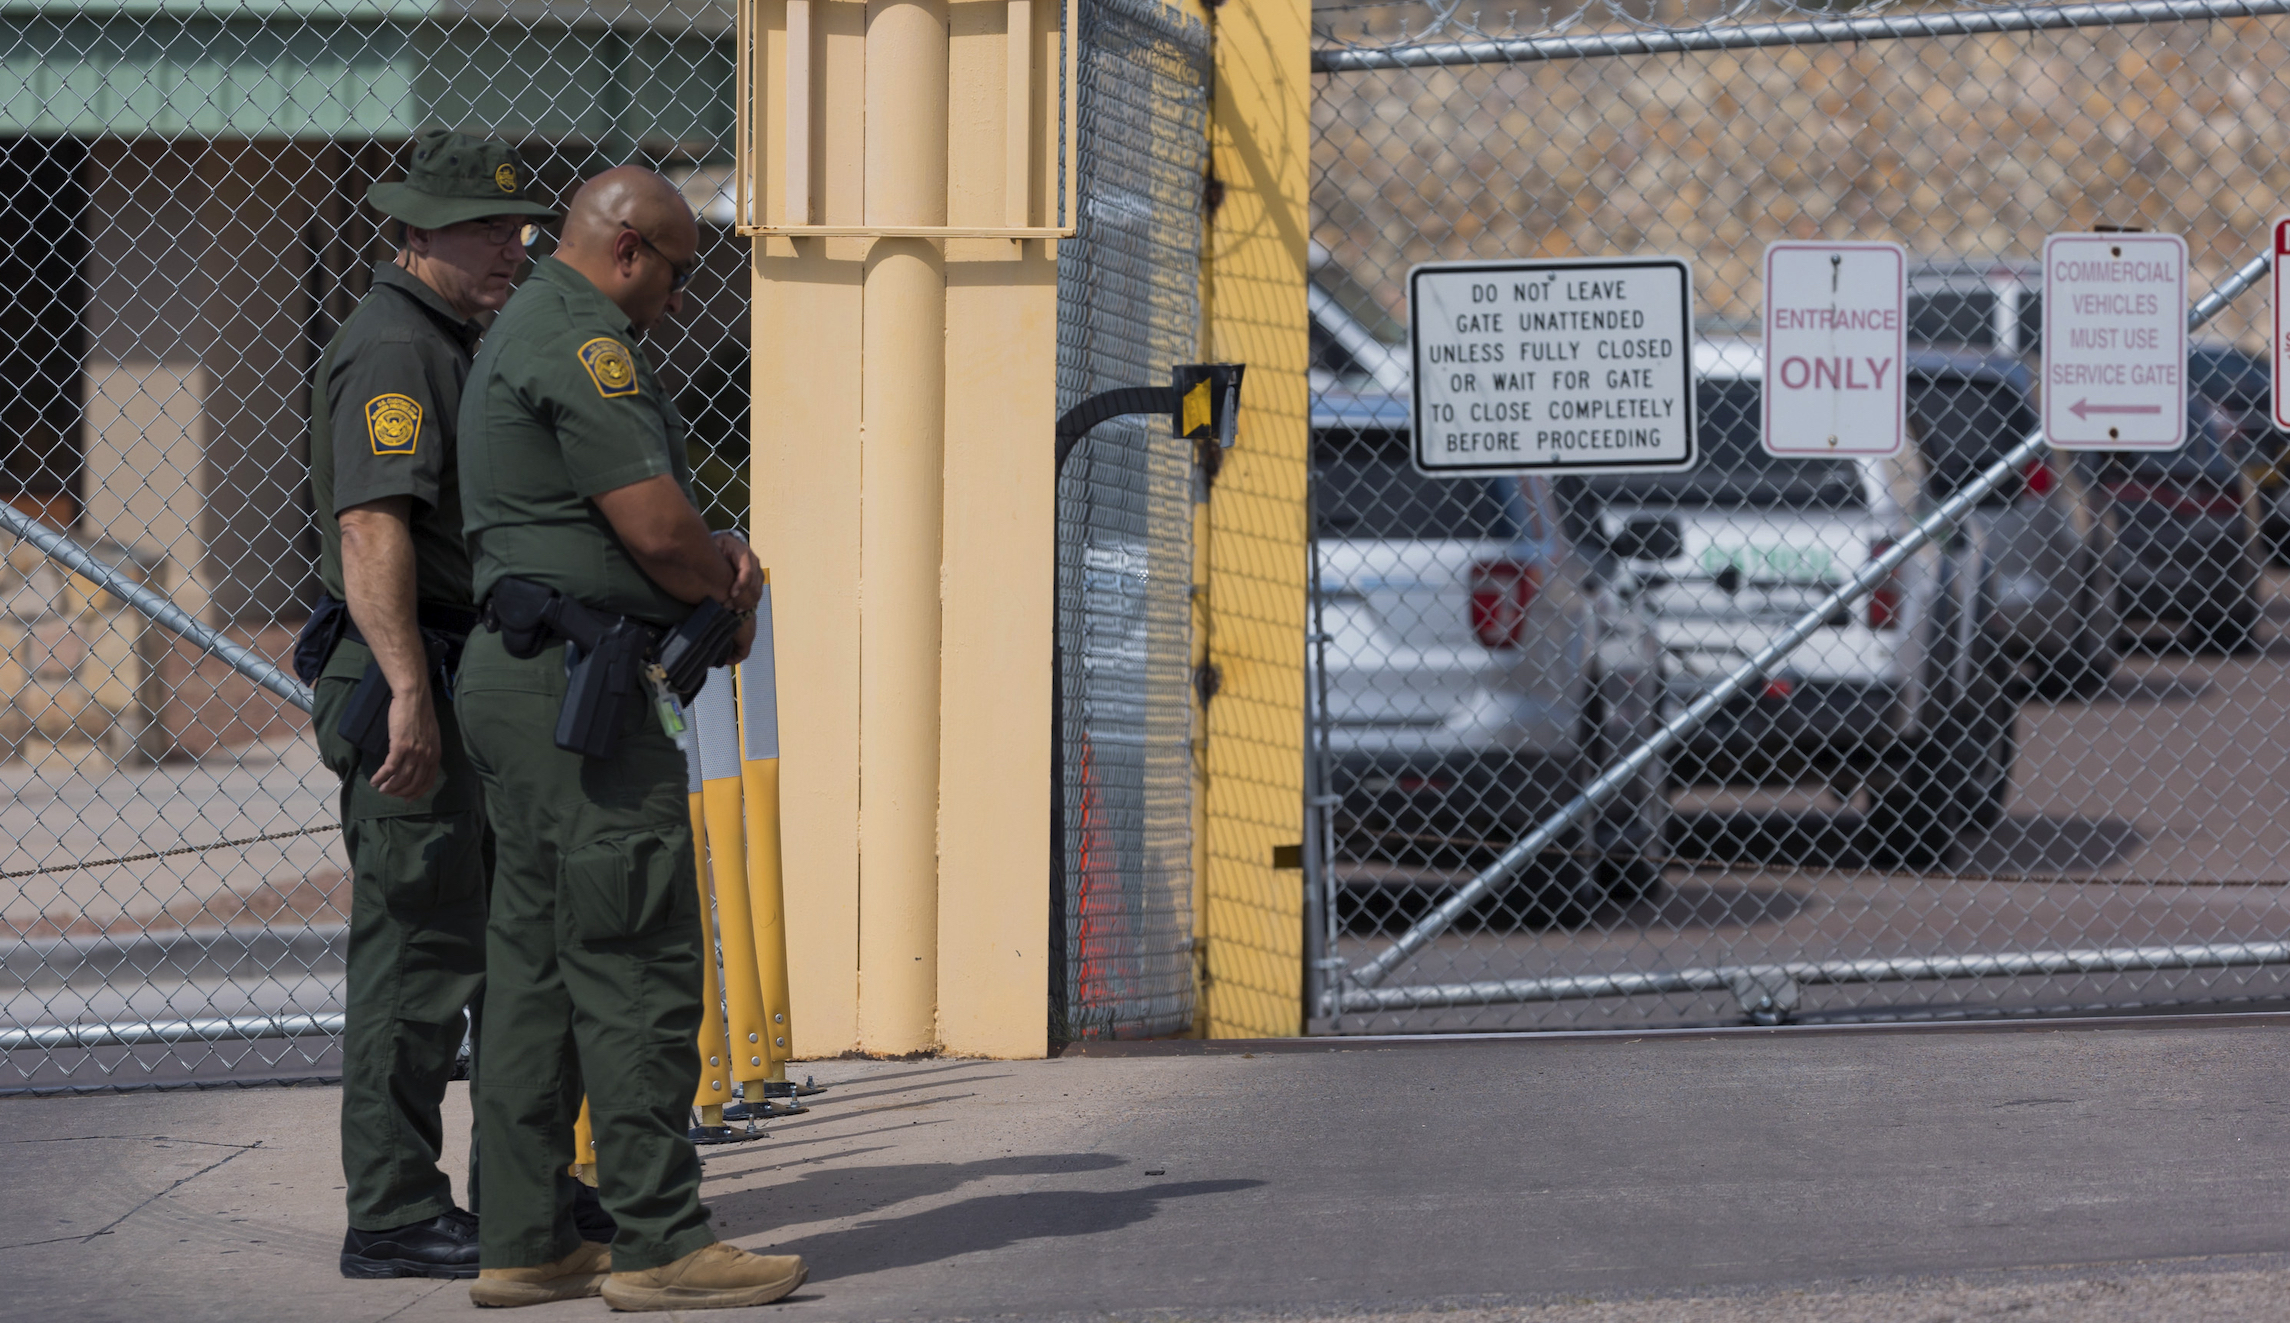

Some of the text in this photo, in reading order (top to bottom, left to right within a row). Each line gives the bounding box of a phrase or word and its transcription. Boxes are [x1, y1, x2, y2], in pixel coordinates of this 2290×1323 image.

[2054, 260, 2175, 283] COMMERCIAL
[1471, 280, 1626, 304] DO NOT LEAVE
[2072, 293, 2158, 316] VEHICLES
[1456, 309, 1644, 334] GATE UNATTENDED
[1775, 308, 1897, 330] ENTRANCE
[2070, 327, 2159, 350] MUST USE
[1429, 338, 1673, 364] UNLESS FULLY CLOSED
[1450, 368, 1653, 393] OR WAIT FOR GATE
[1780, 355, 1892, 391] ONLY
[2053, 364, 2177, 385] SERVICE GATE
[1430, 398, 1673, 424] TO CLOSE COMPLETELY
[1446, 427, 1661, 453] BEFORE PROCEEDING
